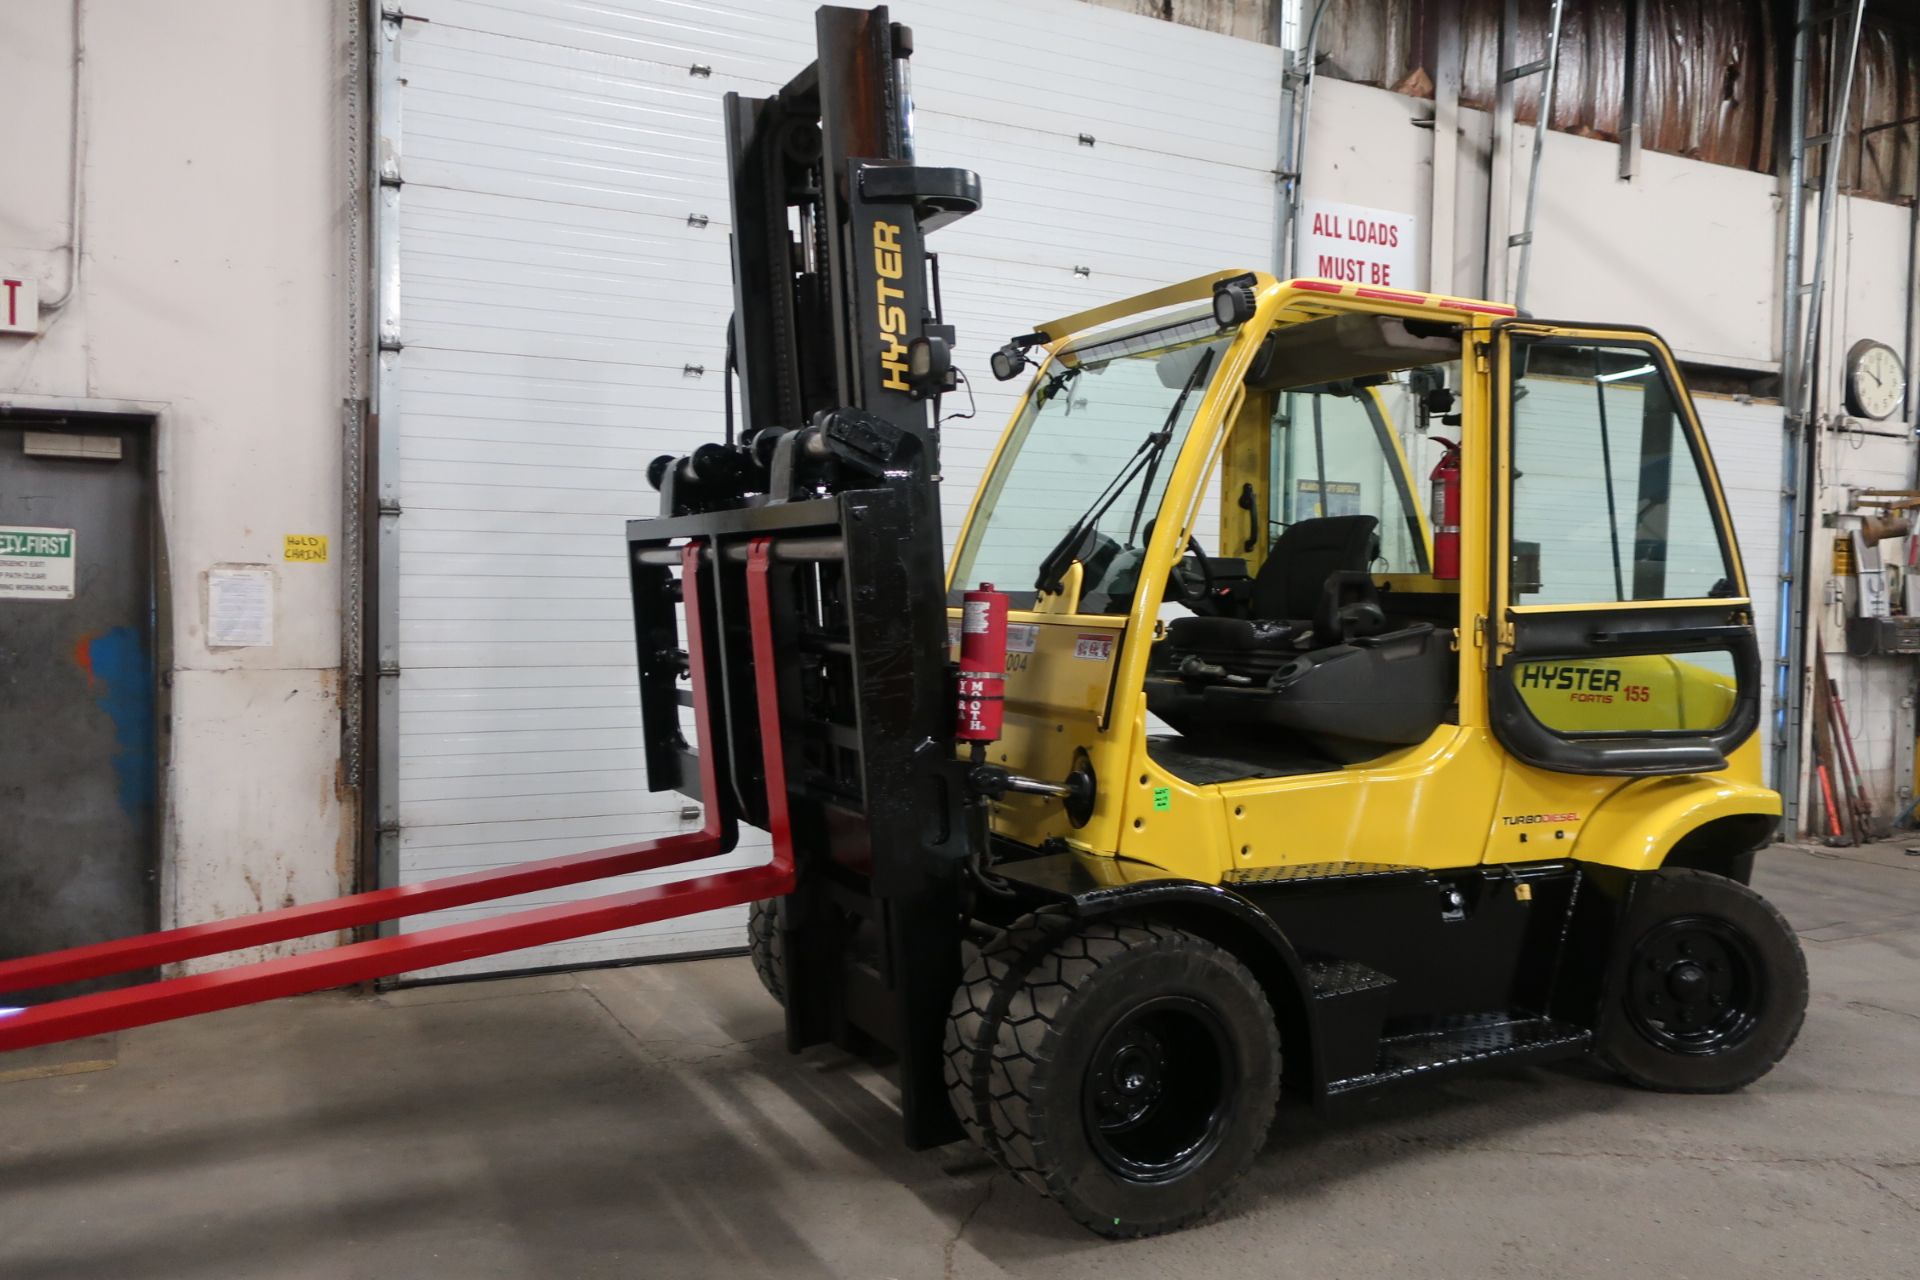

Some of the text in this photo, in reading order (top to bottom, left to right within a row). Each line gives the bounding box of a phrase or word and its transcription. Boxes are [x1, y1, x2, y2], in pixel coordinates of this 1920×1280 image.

[1312, 212, 1398, 248] ALL LOADS
[1319, 254, 1391, 287] MUST BE
[873, 220, 910, 391] HYSTER
[27, 535, 68, 555] FIRST
[1521, 665, 1621, 692] HYSTER
[1570, 692, 1614, 704] FORTIS
[1623, 685, 1650, 702] 155
[1502, 812, 1581, 826] TURBODIESEL
